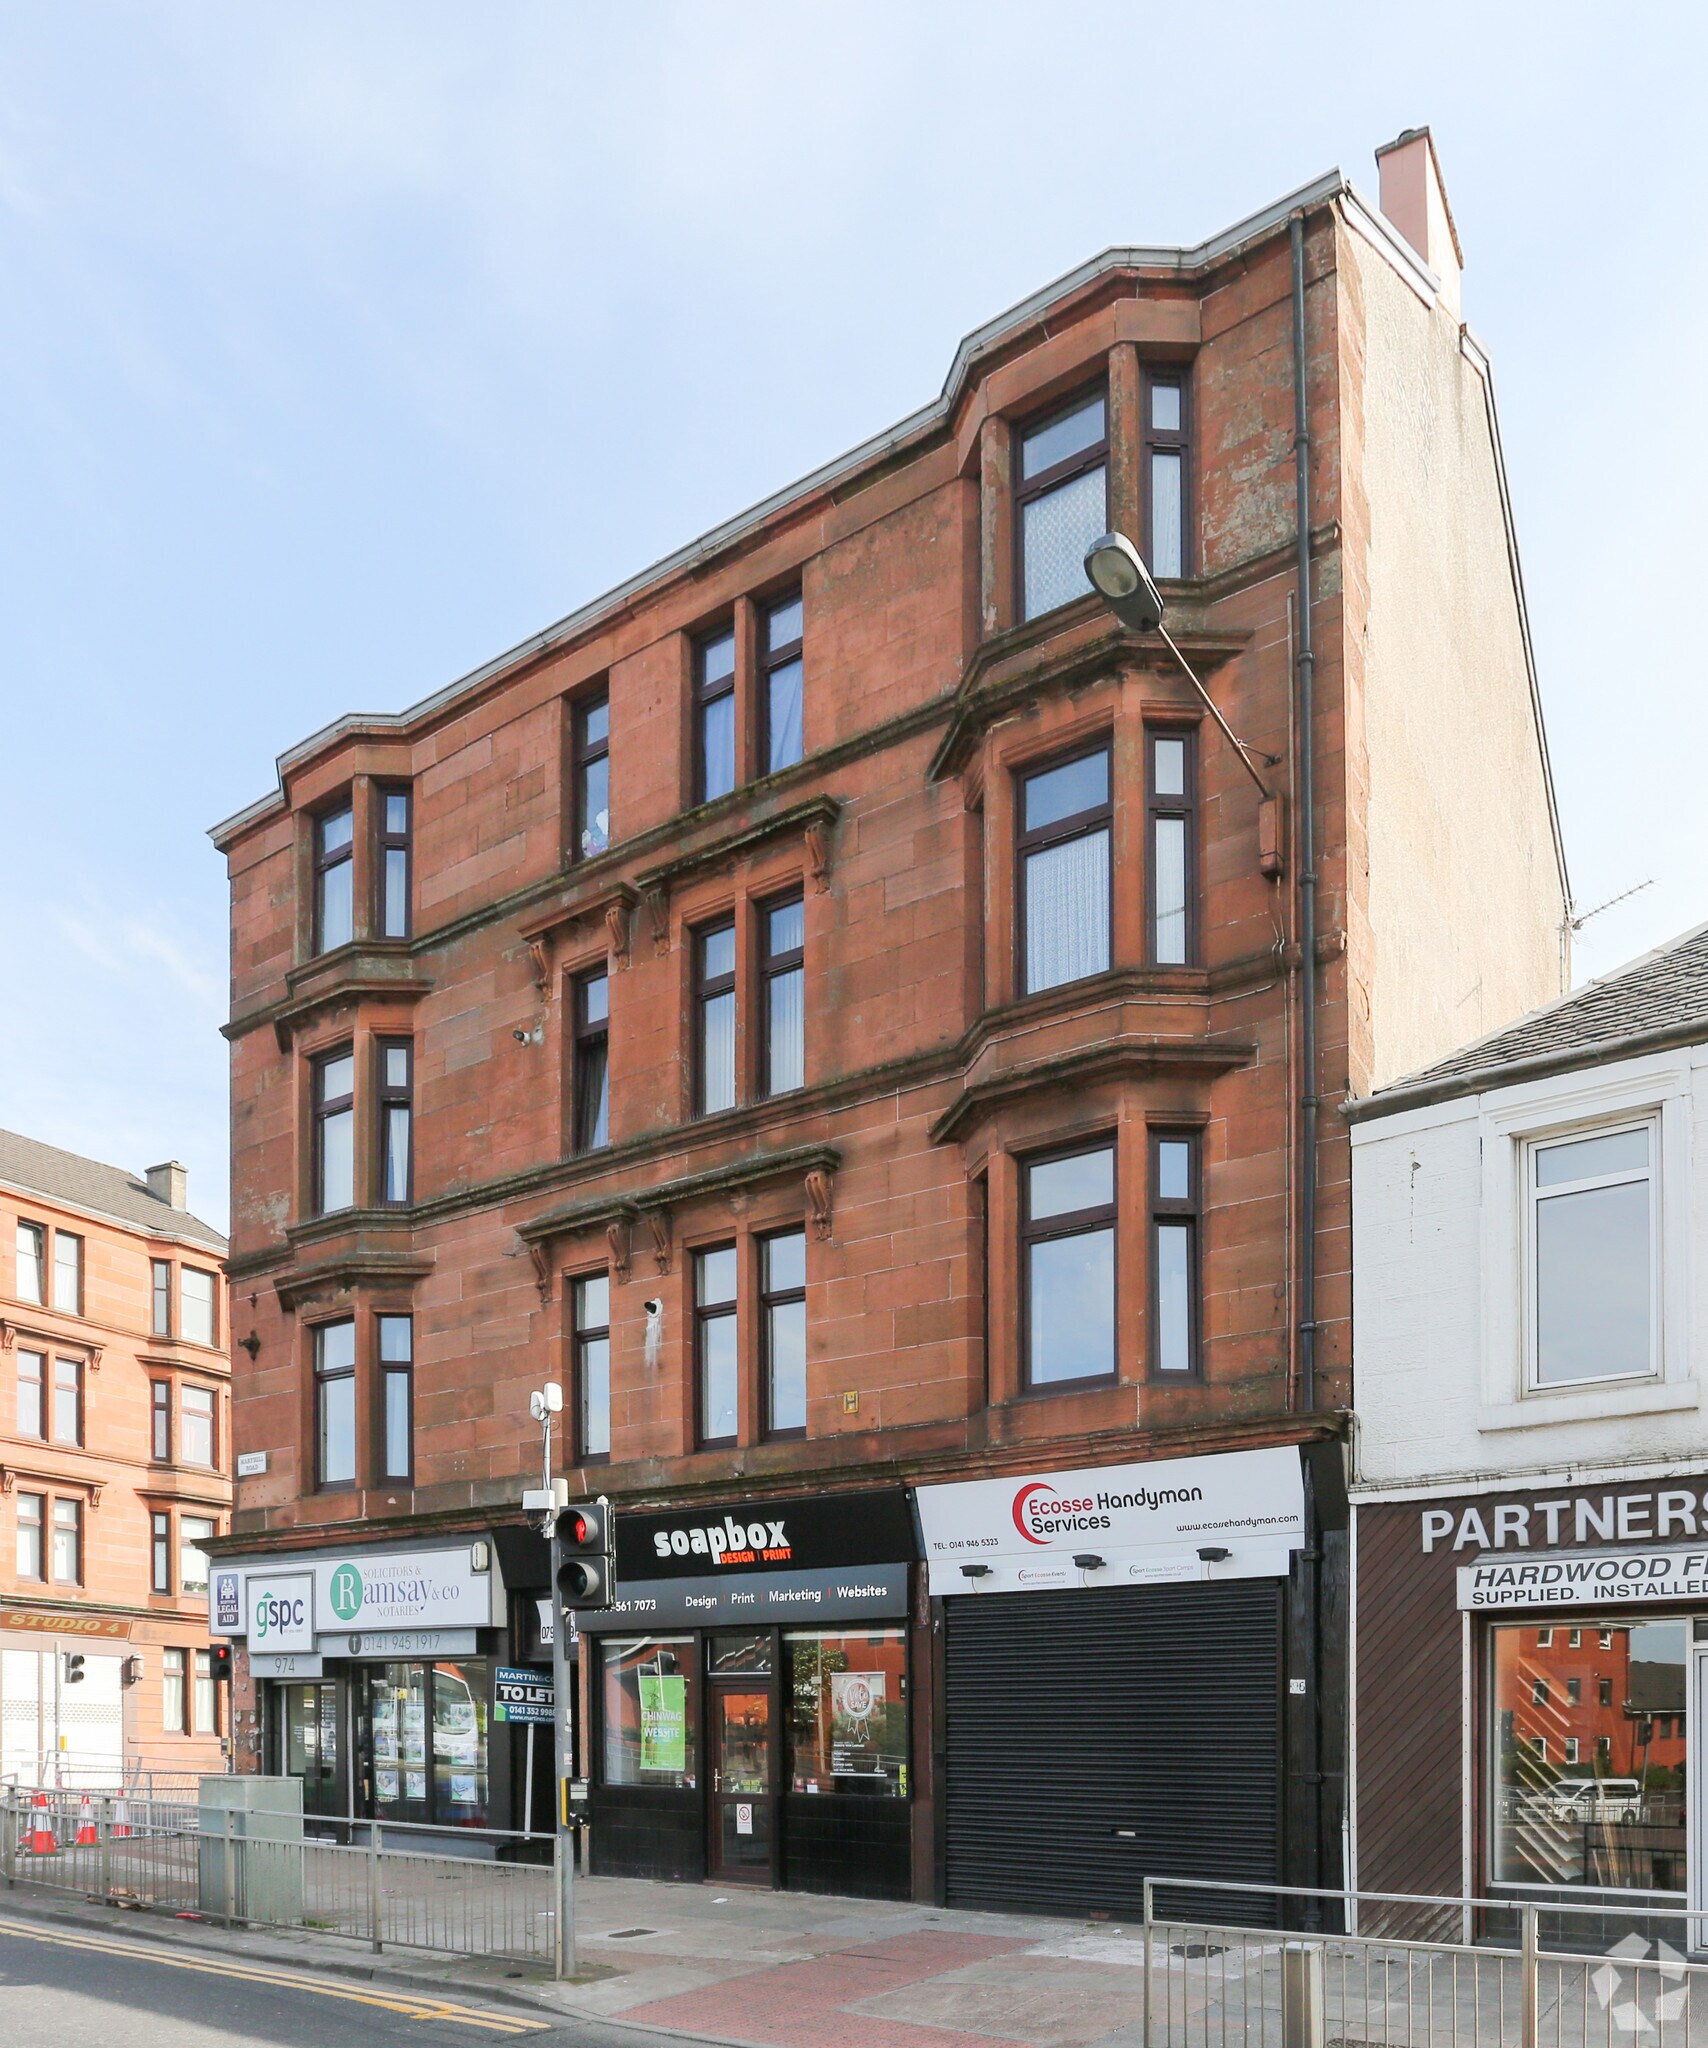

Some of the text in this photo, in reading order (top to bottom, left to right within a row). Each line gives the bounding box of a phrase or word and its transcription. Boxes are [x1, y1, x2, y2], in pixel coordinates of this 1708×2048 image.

[1029, 1487, 1202, 1516] Ecosse Handyman
[1031, 1514, 1111, 1534] Services
[1176, 1514, 1299, 1532] www.ecossehandyman.com
[1421, 1489, 1708, 1554] PARTNER
[653, 1516, 791, 1565] soapbox
[933, 1538, 999, 1550] TEL: 0141 946 5323
[720, 1548, 792, 1564] DESIGN PRINT
[363, 1566, 413, 1579] SOLICITORS
[1473, 1554, 1708, 1588] HARDWOOD F
[336, 1573, 432, 1611] Ramsay
[685, 1585, 888, 1609] Design Print Marketing Websites
[1472, 1586, 1581, 1605] SUPPLIED.
[218, 1604, 238, 1613] LEGAL
[377, 1606, 419, 1617] NOTARIES
[615, 1601, 632, 1612] 561
[634, 1599, 657, 1611] 7073
[9, 1614, 101, 1631] STUDIO
[106, 1623, 119, 1633] 4
[222, 1614, 235, 1623] AID
[256, 1599, 304, 1638] gspc
[363, 1636, 387, 1650] 0141
[392, 1635, 411, 1650] 945
[416, 1634, 440, 1649] 1917
[274, 1657, 295, 1673] 974
[500, 1685, 554, 1703] TO LET
[509, 1705, 525, 1714] 0141
[526, 1706, 539, 1715] 352
[641, 1711, 682, 1721] CHINWAG
[644, 1727, 680, 1737] WEBSITE
